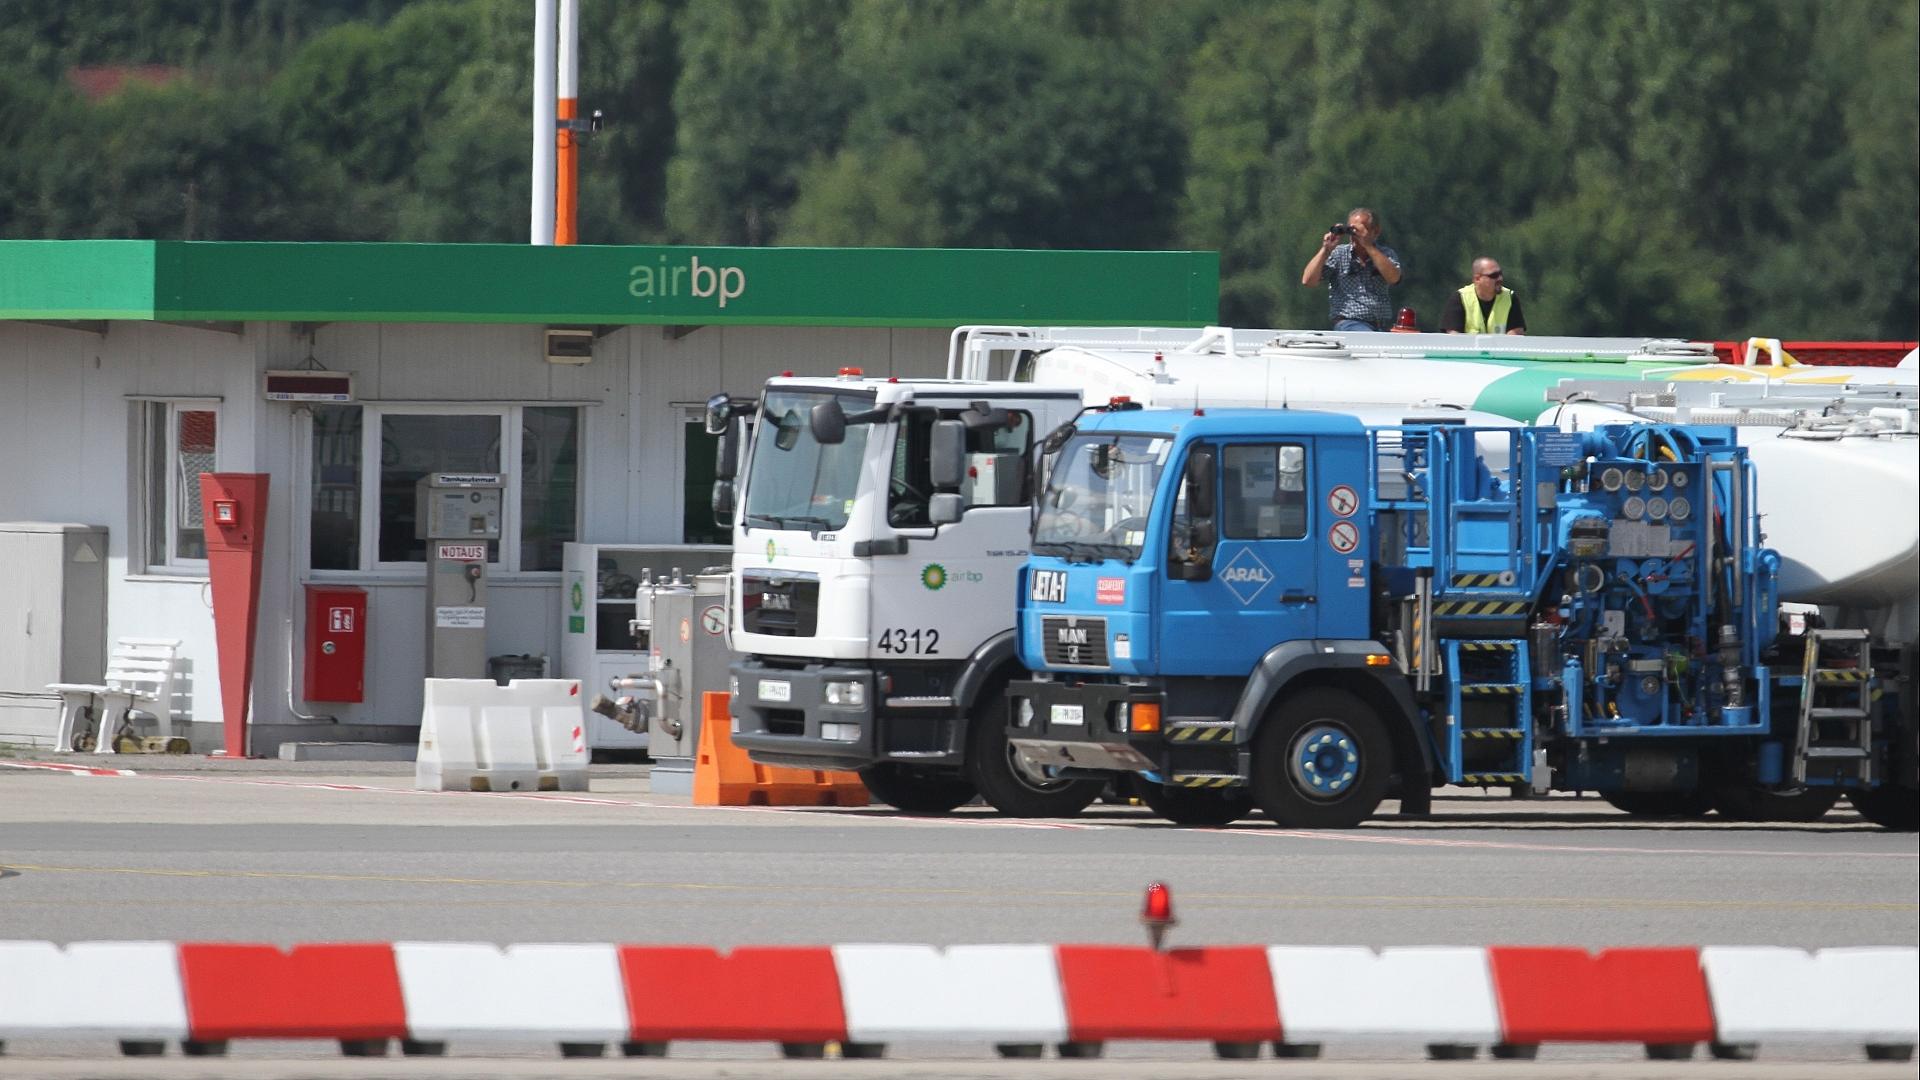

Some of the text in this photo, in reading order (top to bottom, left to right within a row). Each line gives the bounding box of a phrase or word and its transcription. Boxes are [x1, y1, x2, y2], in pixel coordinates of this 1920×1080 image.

[441, 547, 482, 558] NOTAUS
[1225, 567, 1267, 582] ARAL
[877, 628, 940, 654] 4312
[1058, 628, 1088, 644] MAN
